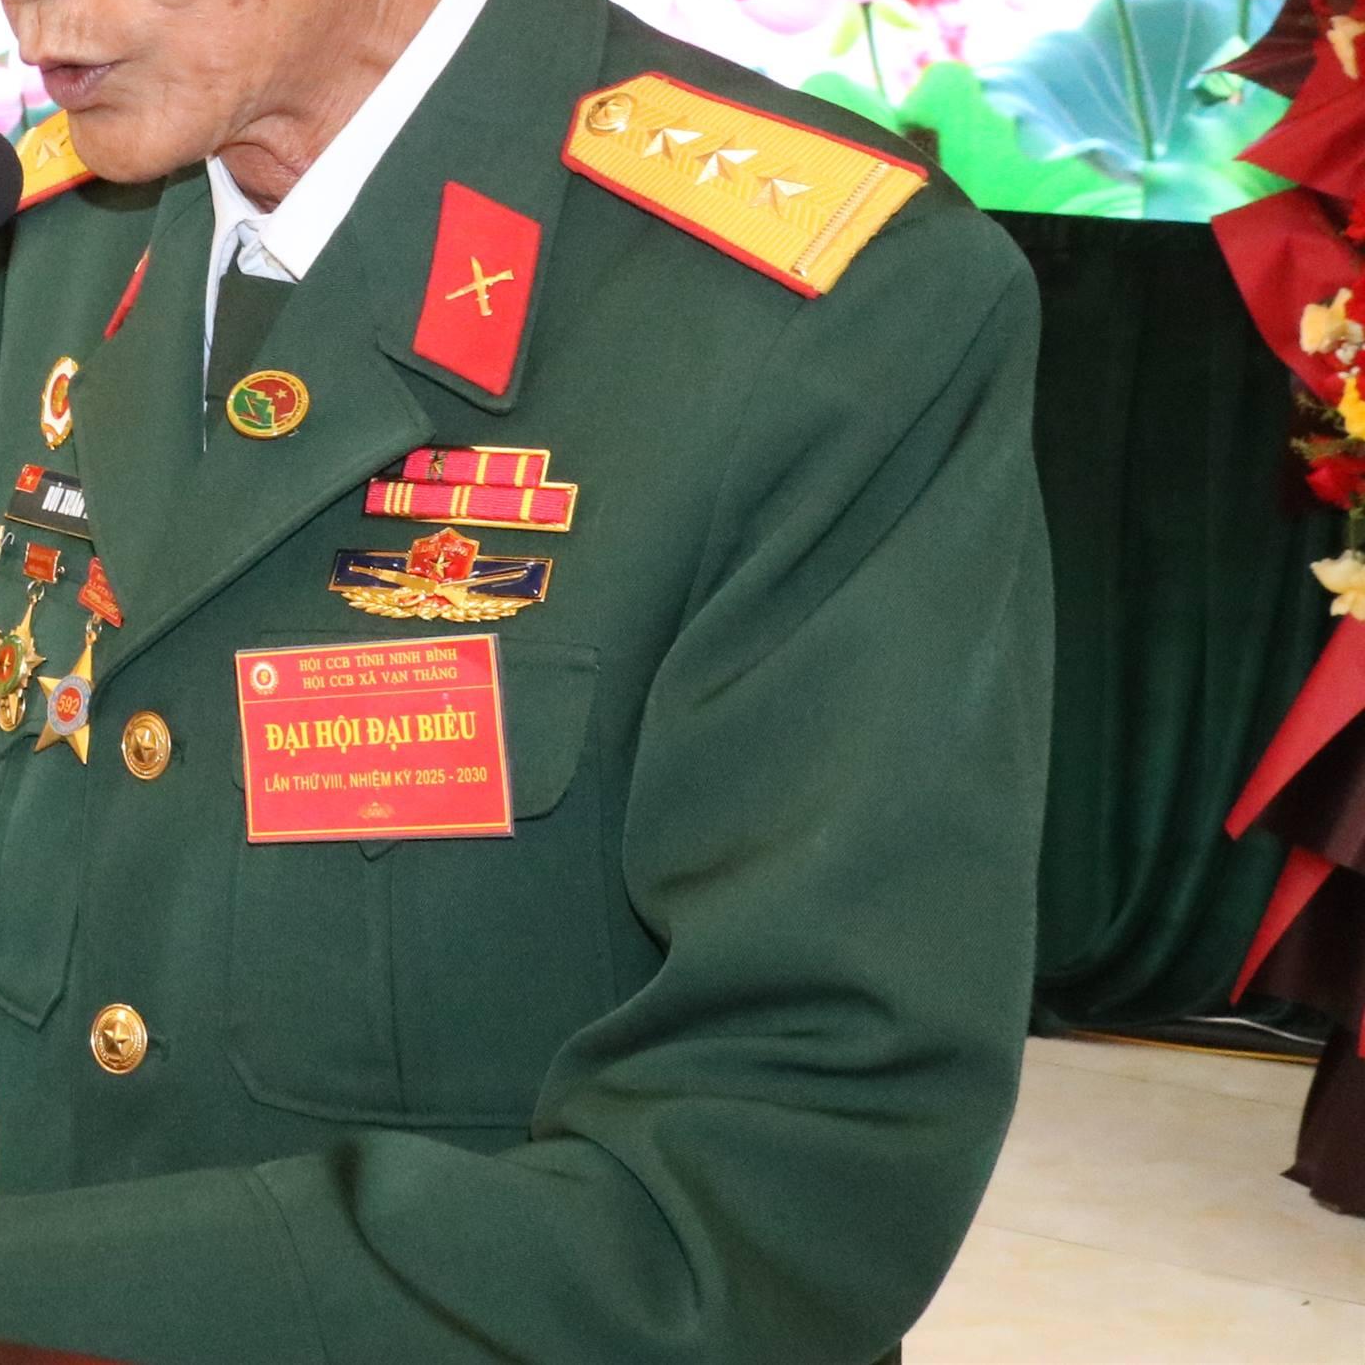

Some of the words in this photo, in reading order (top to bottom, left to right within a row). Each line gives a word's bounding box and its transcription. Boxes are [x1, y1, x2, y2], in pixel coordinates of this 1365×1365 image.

[299, 657, 320, 672] HỘI
[325, 656, 350, 669] CCB
[355, 652, 384, 668] TỈNH
[389, 651, 421, 665] NINH
[425, 647, 457, 663] BÌNH
[303, 675, 325, 690] HỘI
[329, 674, 354, 688] CCB
[381, 670, 408, 685] VẠN
[57, 694, 80, 715] 592
[265, 722, 310, 757] ĐẠI
[313, 715, 362, 754] HỘI
[366, 715, 412, 751] ĐẠI
[416, 704, 476, 741] BIỂU
[350, 768, 391, 790] NHIỆM
[416, 768, 445, 785] 2025
[456, 766, 488, 783] 2030
